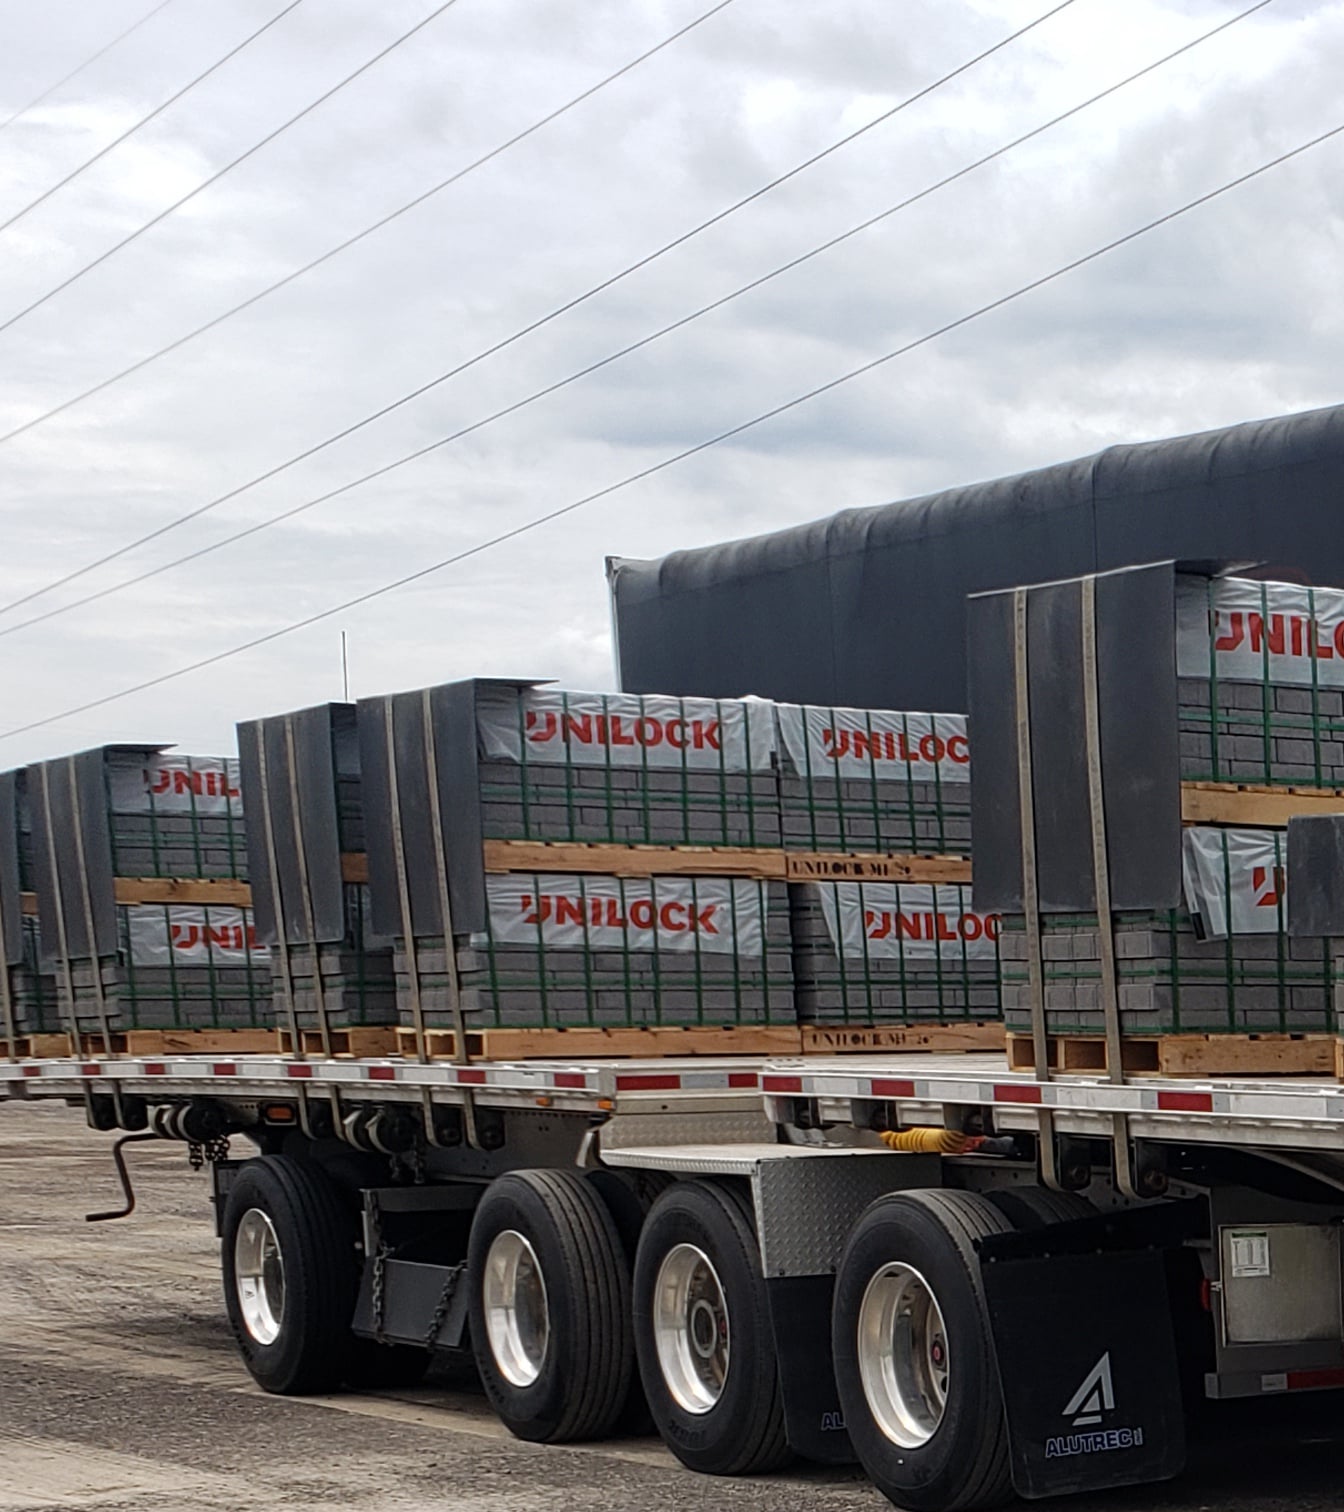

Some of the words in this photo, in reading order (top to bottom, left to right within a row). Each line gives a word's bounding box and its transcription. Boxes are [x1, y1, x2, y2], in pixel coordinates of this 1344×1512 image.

[526, 710, 721, 750] UNILOCK
[822, 729, 969, 764] UNILOC
[143, 769, 240, 797] UNIL
[520, 895, 719, 934] UNILOCK
[866, 910, 1003, 942] UNILOC
[171, 924, 267, 950] UNIL
[1045, 1428, 1133, 1458] ALUTREC
